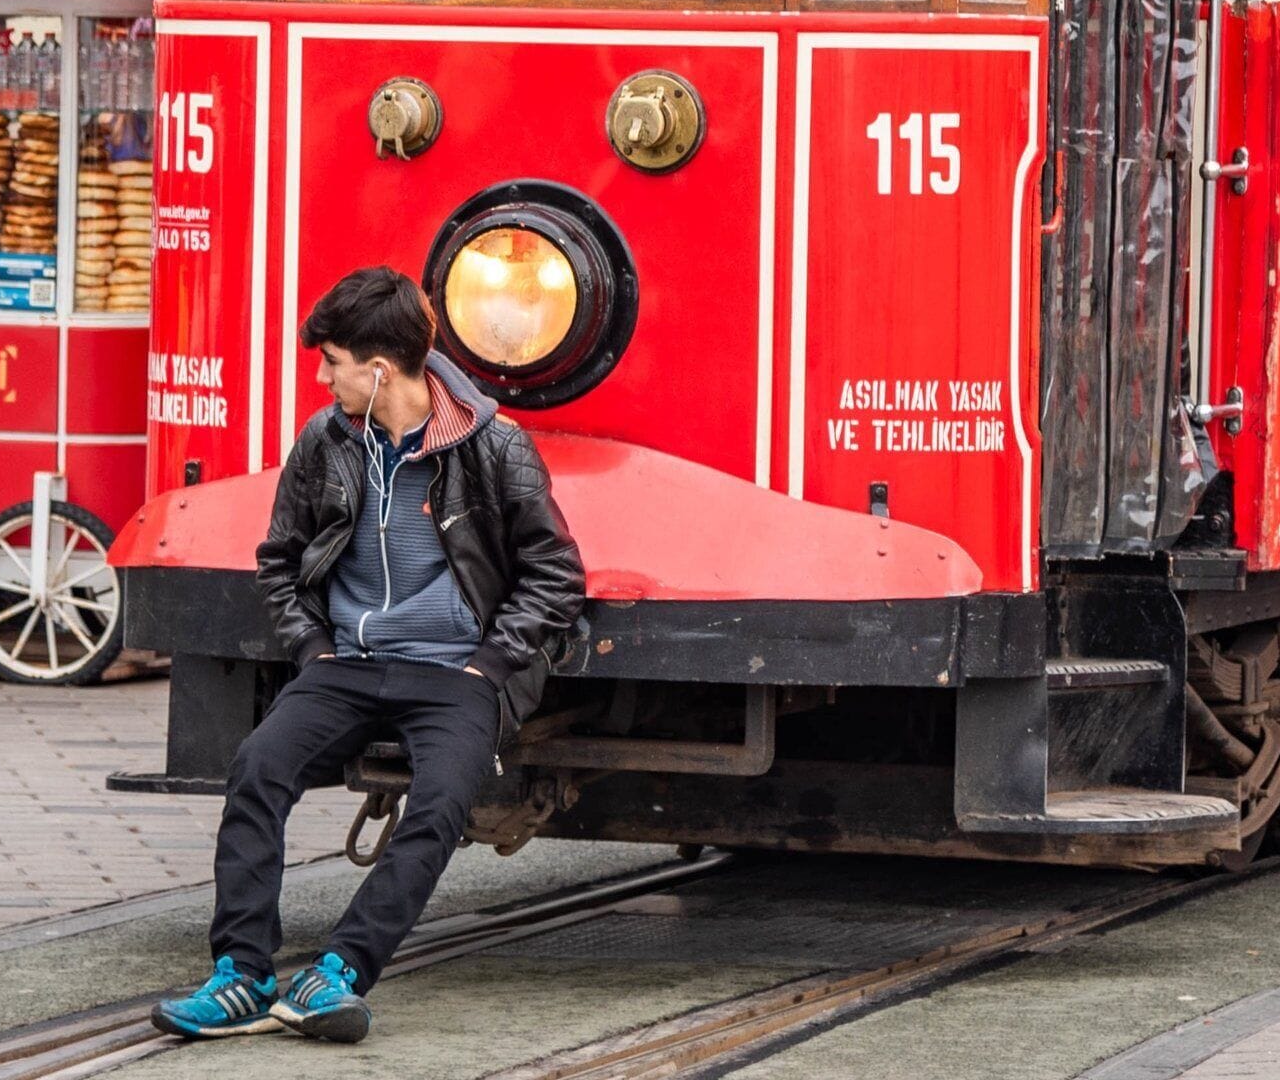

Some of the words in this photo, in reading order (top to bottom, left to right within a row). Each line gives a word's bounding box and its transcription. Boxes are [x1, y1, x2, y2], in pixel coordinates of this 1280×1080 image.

[159, 91, 214, 174] 115
[866, 112, 961, 195] 115
[158, 227, 180, 250] ALO
[182, 229, 211, 252] 153
[171, 353, 224, 388] YASAK
[839, 379, 939, 412] ASILMAK
[948, 380, 1002, 412] YASAK
[827, 418, 860, 451] VE
[871, 415, 1005, 452] TEHLİKELİDİR
